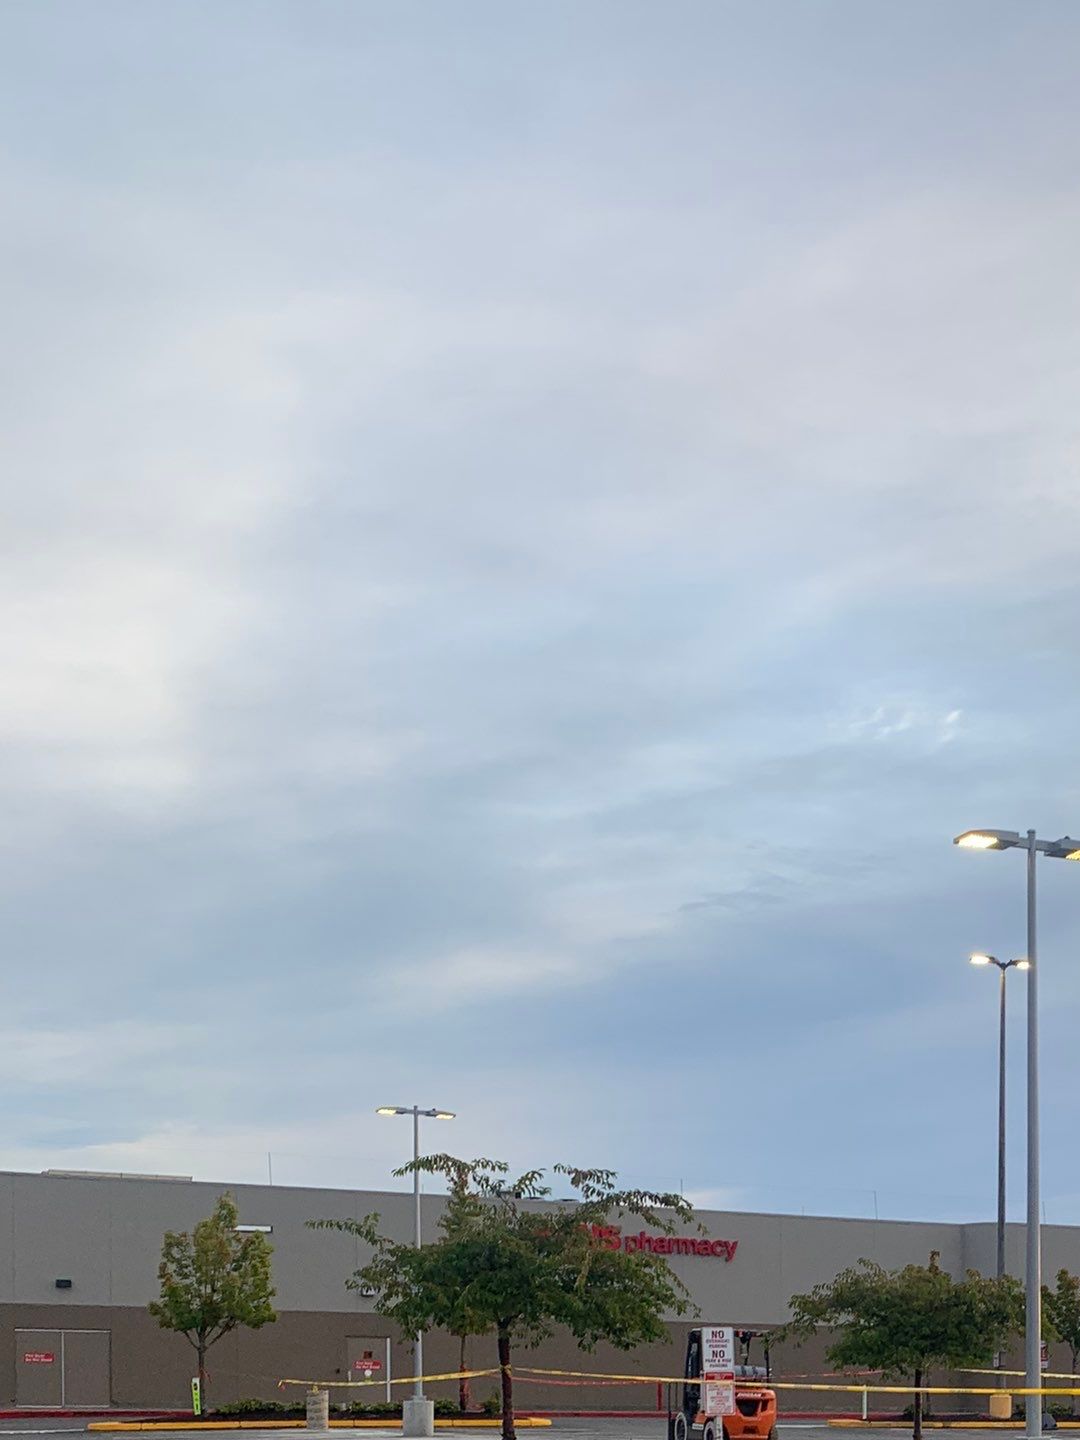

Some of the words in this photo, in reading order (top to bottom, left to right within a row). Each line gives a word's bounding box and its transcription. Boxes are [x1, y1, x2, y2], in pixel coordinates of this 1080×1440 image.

[624, 1231, 739, 1262] pharmacy
[711, 1330, 724, 1338] NO
[712, 1350, 725, 1358] NO
